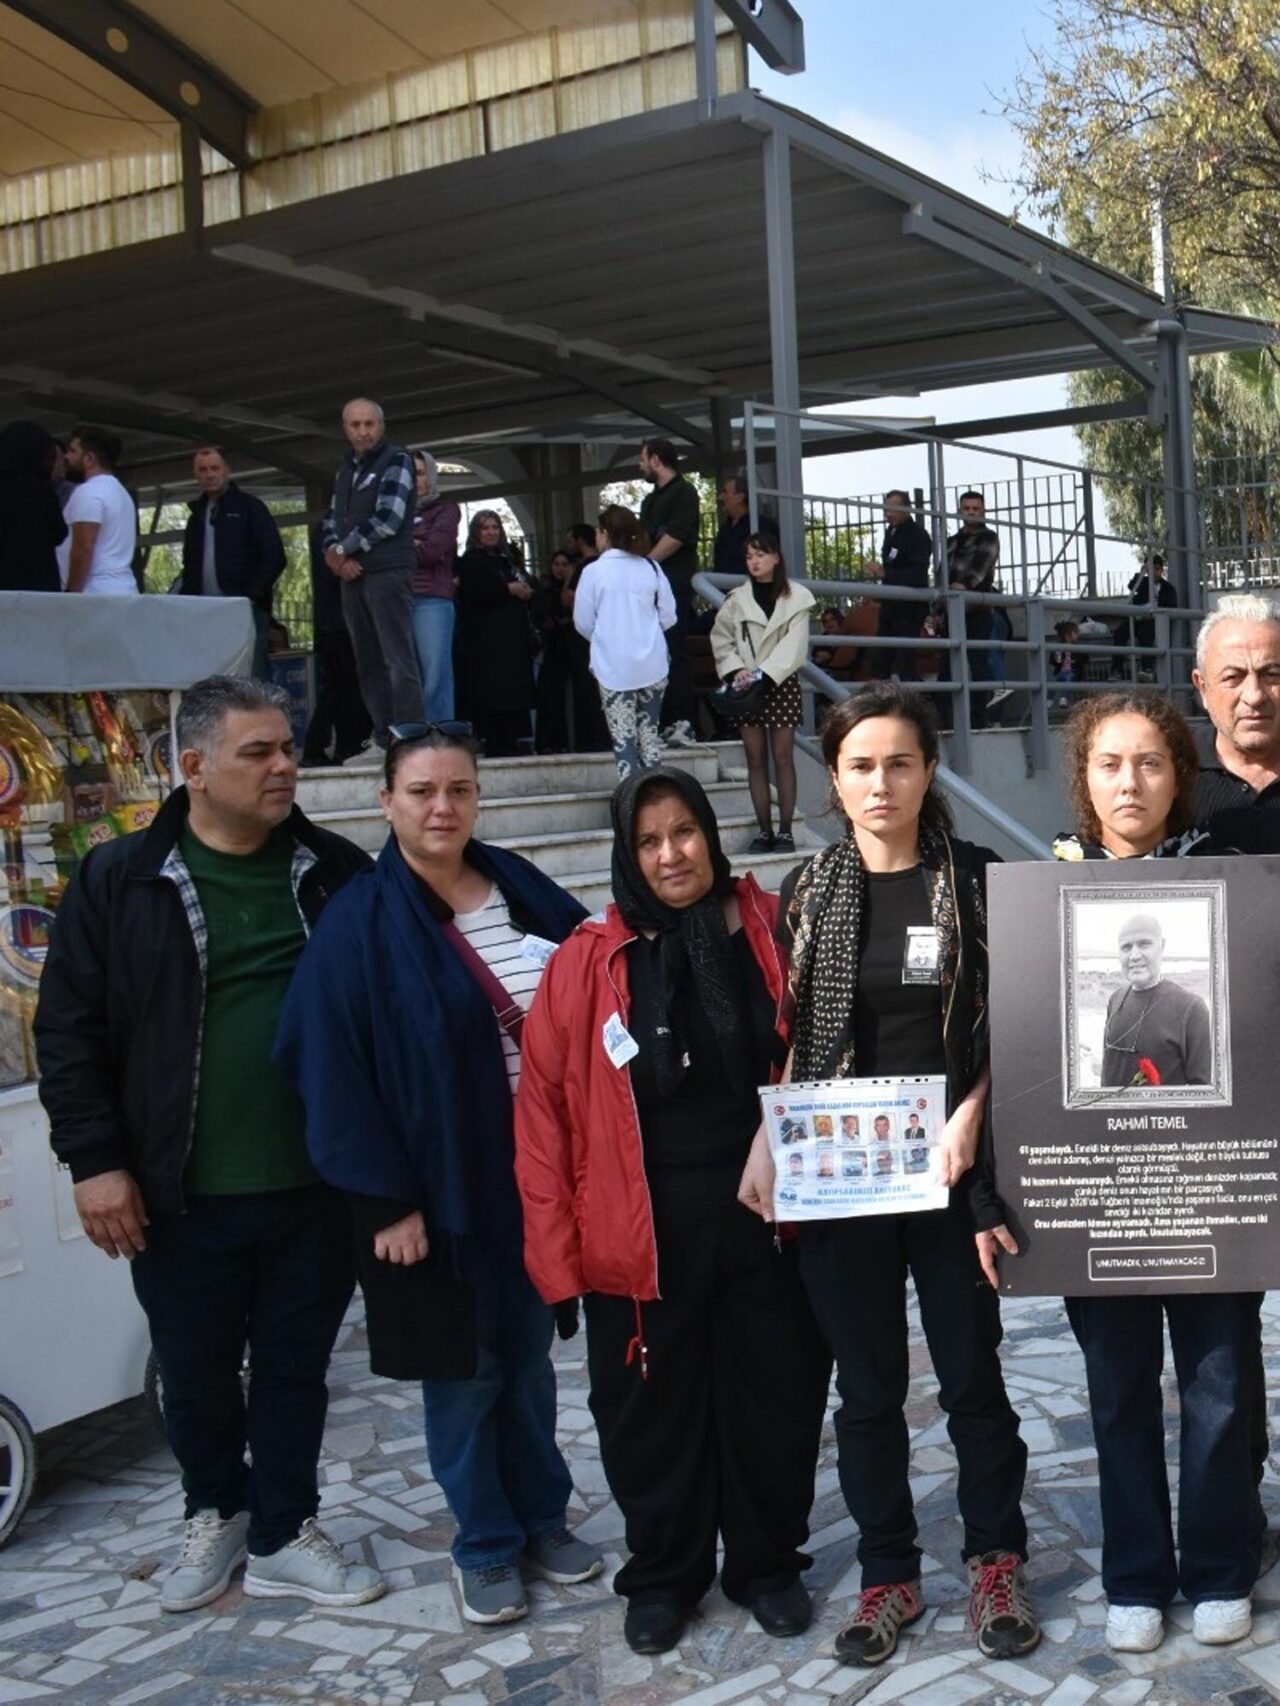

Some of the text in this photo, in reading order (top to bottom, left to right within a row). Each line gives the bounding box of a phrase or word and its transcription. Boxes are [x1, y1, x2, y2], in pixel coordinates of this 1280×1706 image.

[1107, 1116, 1187, 1131] RAHMİ TEMEL
[1100, 1144, 1110, 1153] bir
[1147, 1154, 1156, 1162] bir
[1034, 1220, 1050, 1229] Onu
[1051, 1219, 1087, 1228] denizden
